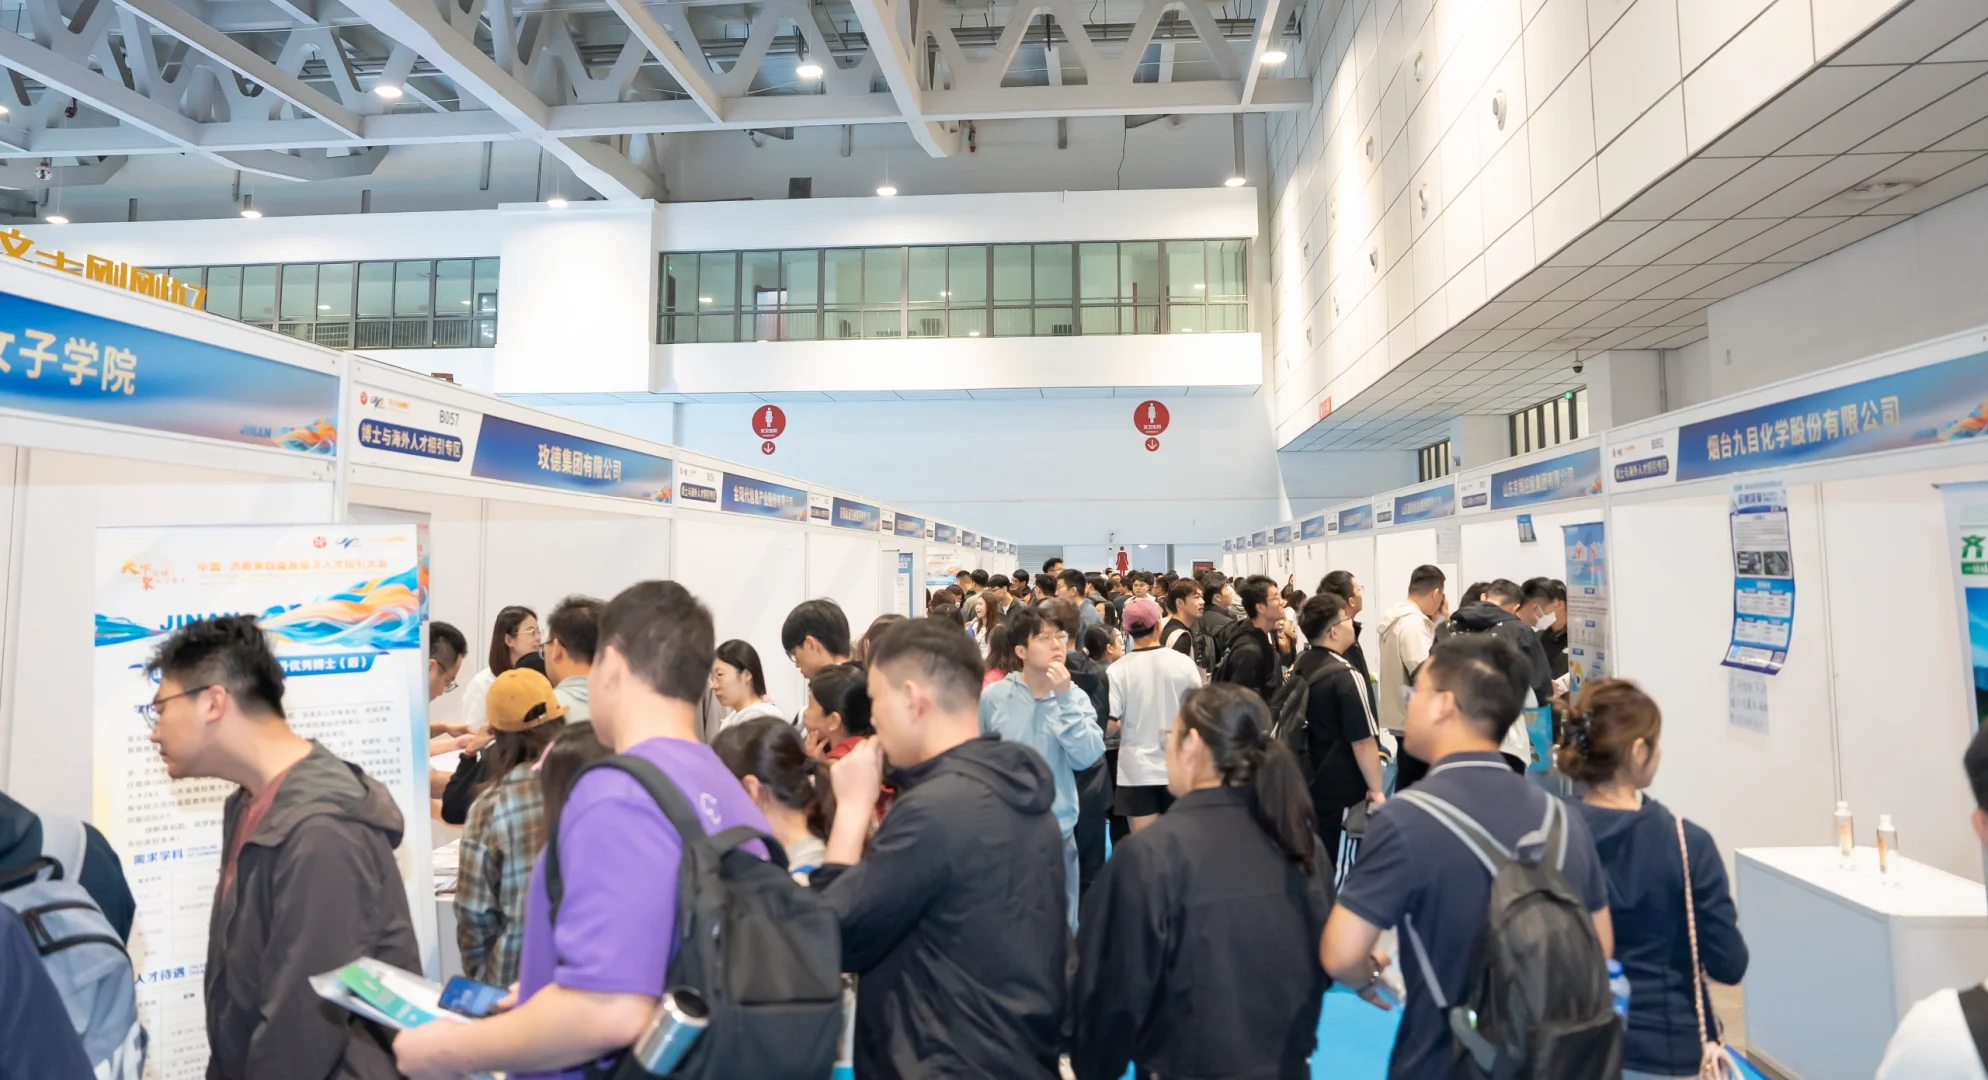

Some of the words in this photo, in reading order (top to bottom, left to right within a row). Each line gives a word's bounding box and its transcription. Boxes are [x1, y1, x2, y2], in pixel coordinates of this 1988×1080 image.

[438, 409, 460, 426] B057
[1707, 396, 1900, 460] 烟台九目化学股份有限公司
[361, 423, 462, 460] 博士与海外人才招引专区
[537, 443, 622, 483] 玫德集团有限公司
[133, 848, 184, 865] 需求学科
[134, 966, 185, 985] 人才待遇
